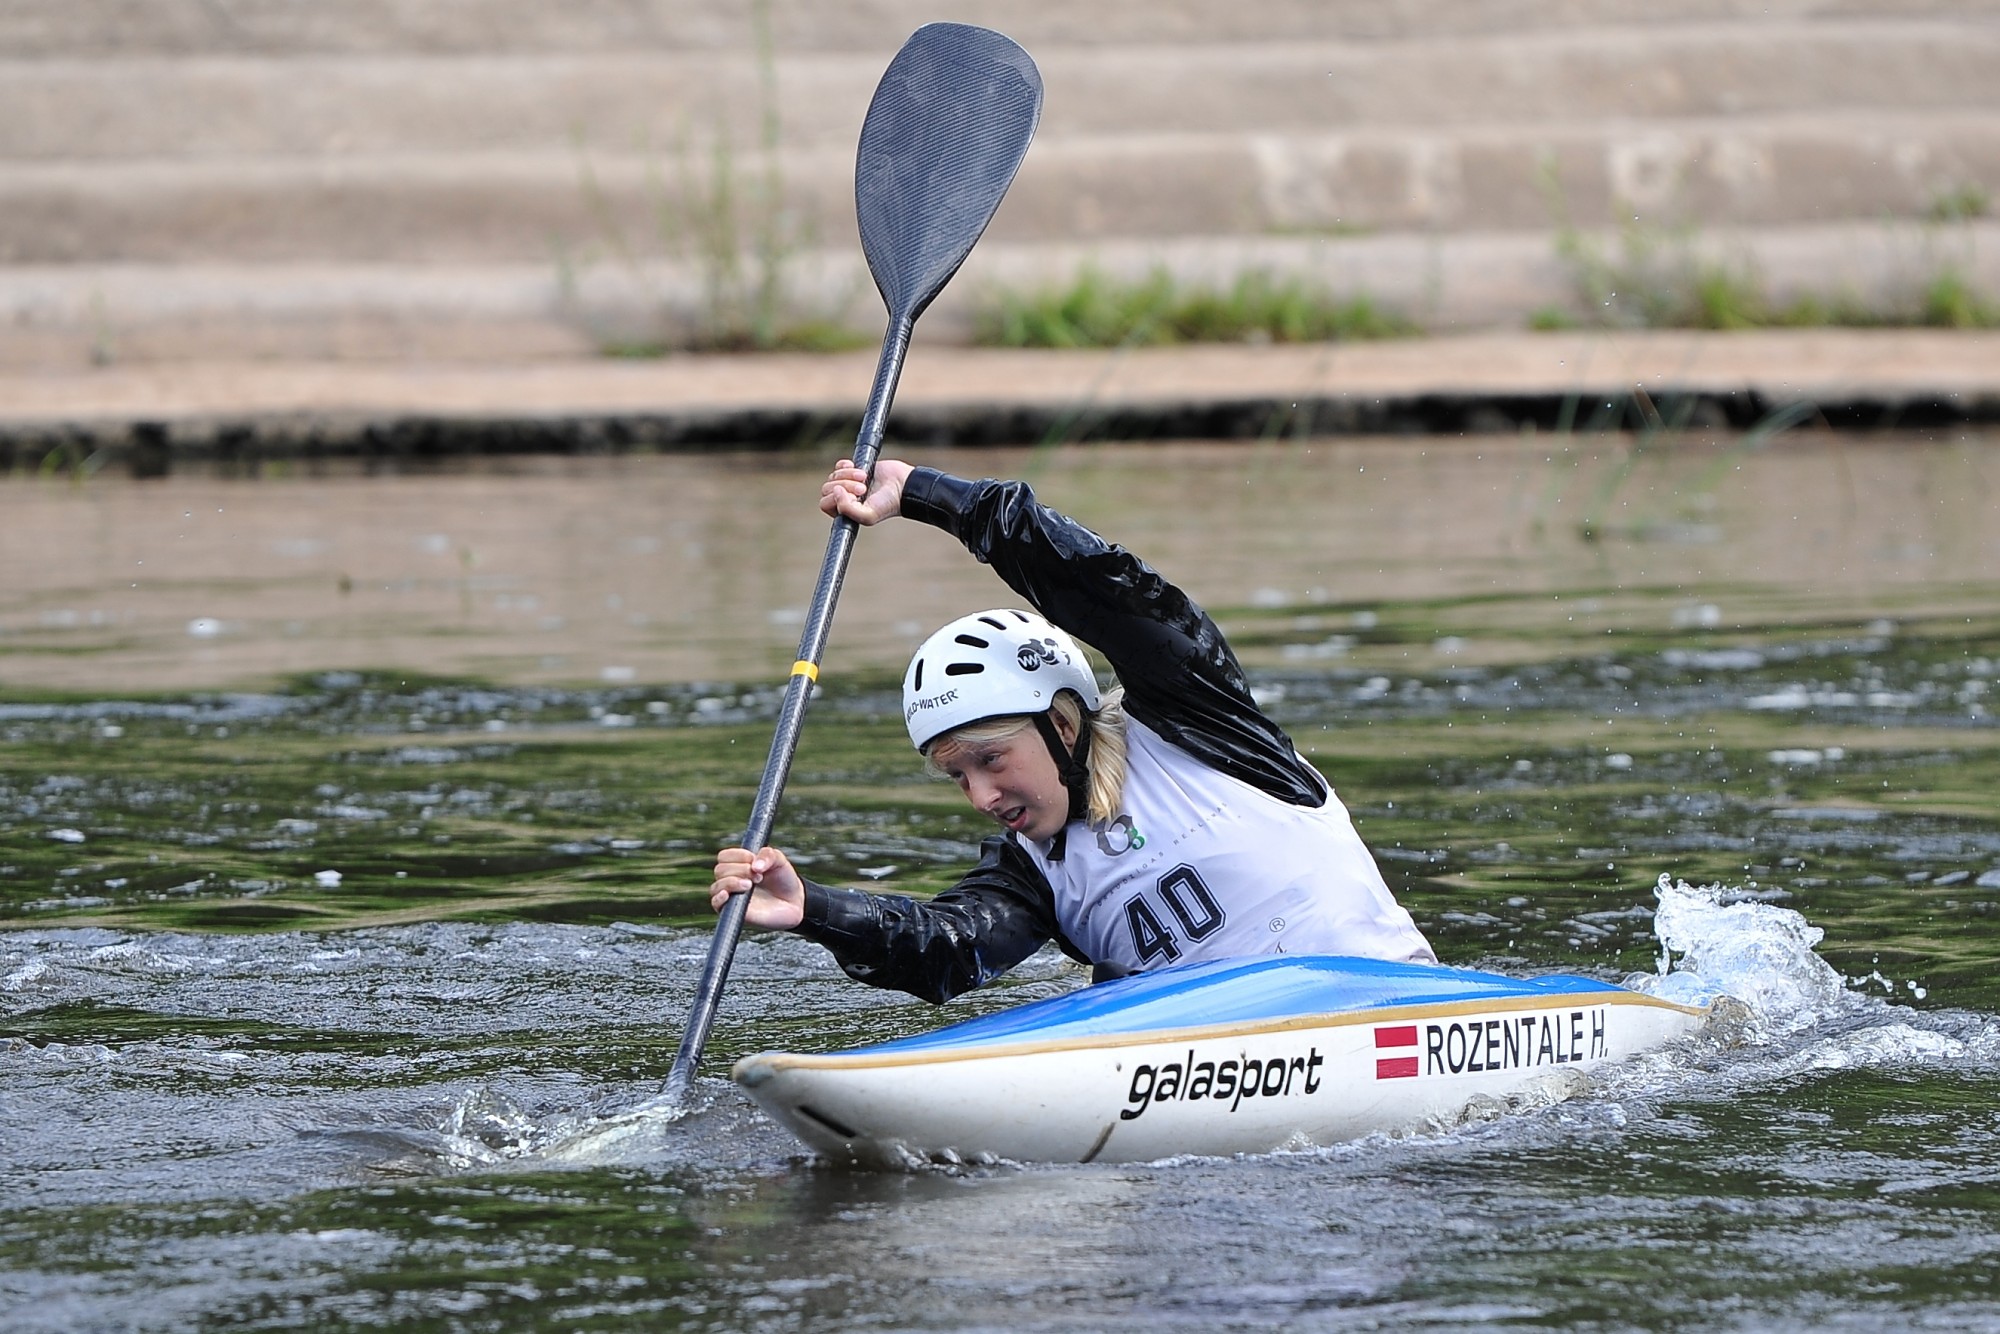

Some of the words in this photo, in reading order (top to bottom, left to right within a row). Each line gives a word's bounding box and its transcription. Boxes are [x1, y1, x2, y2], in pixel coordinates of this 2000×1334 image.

[1123, 862, 1227, 966] 40
[1426, 1011, 1583, 1076] ROZENTALE
[1590, 1009, 1608, 1059] H.
[1120, 1047, 1324, 1121] galasport
